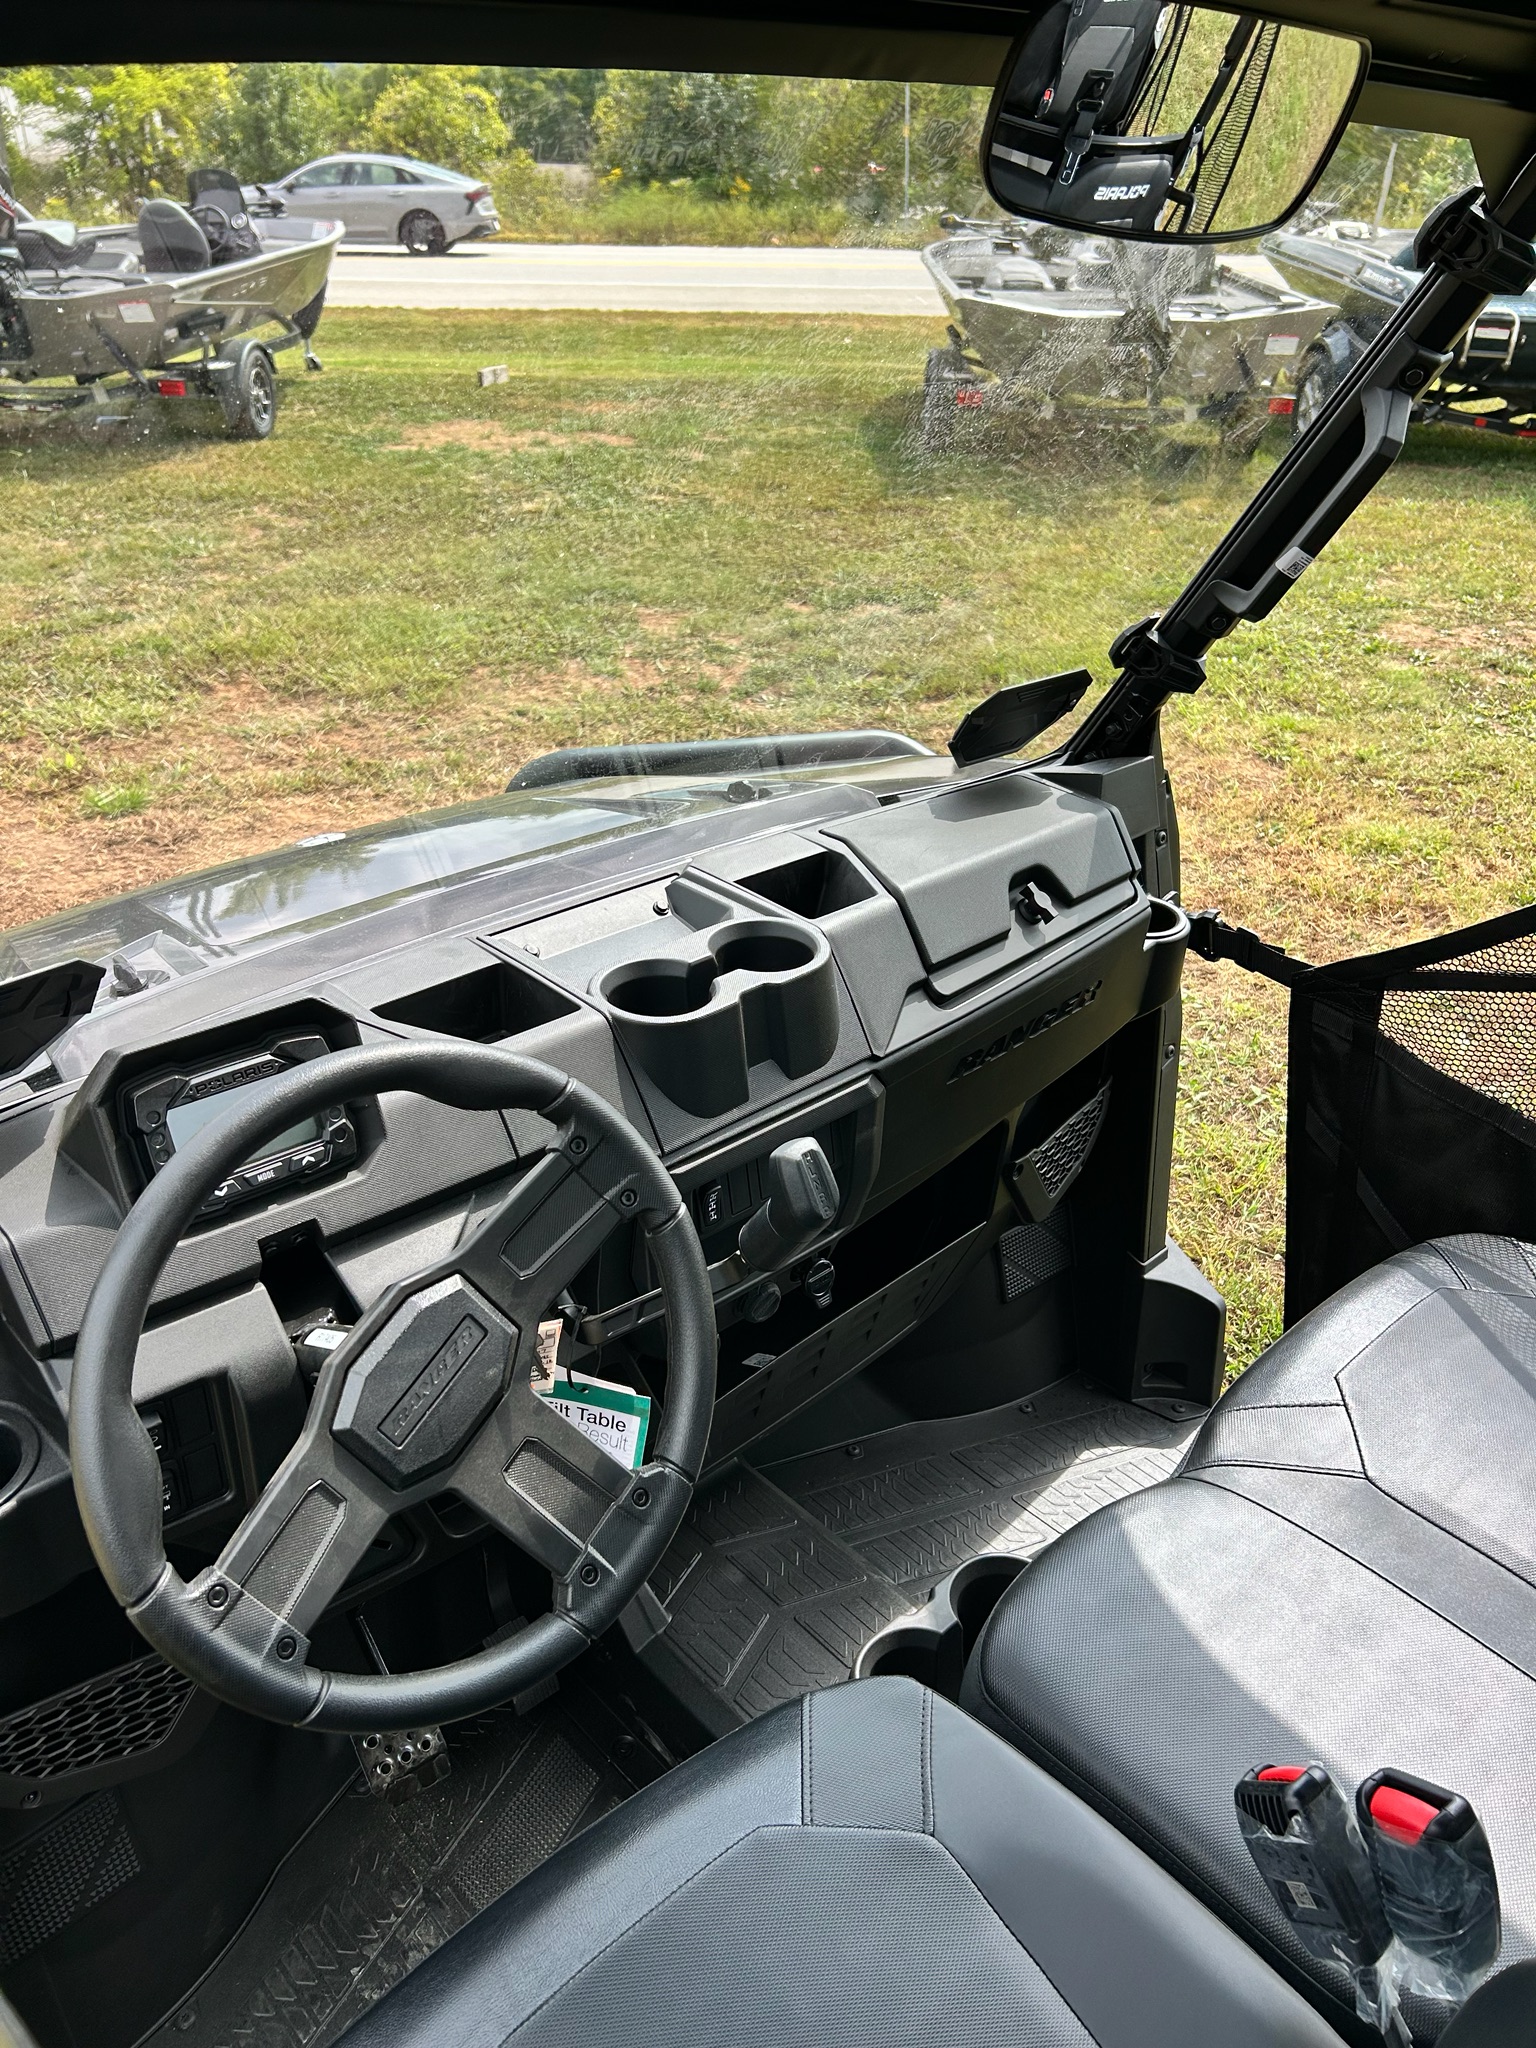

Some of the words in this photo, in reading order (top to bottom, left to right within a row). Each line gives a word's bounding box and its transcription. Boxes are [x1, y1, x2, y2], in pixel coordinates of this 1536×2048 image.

[946, 980, 1103, 1085] RANGER
[195, 1061, 274, 1095] POLARIS
[257, 1170, 276, 1182] MODE
[392, 1326, 473, 1435] RANGER
[549, 1401, 571, 1418] ilt
[576, 1406, 627, 1433] Table
